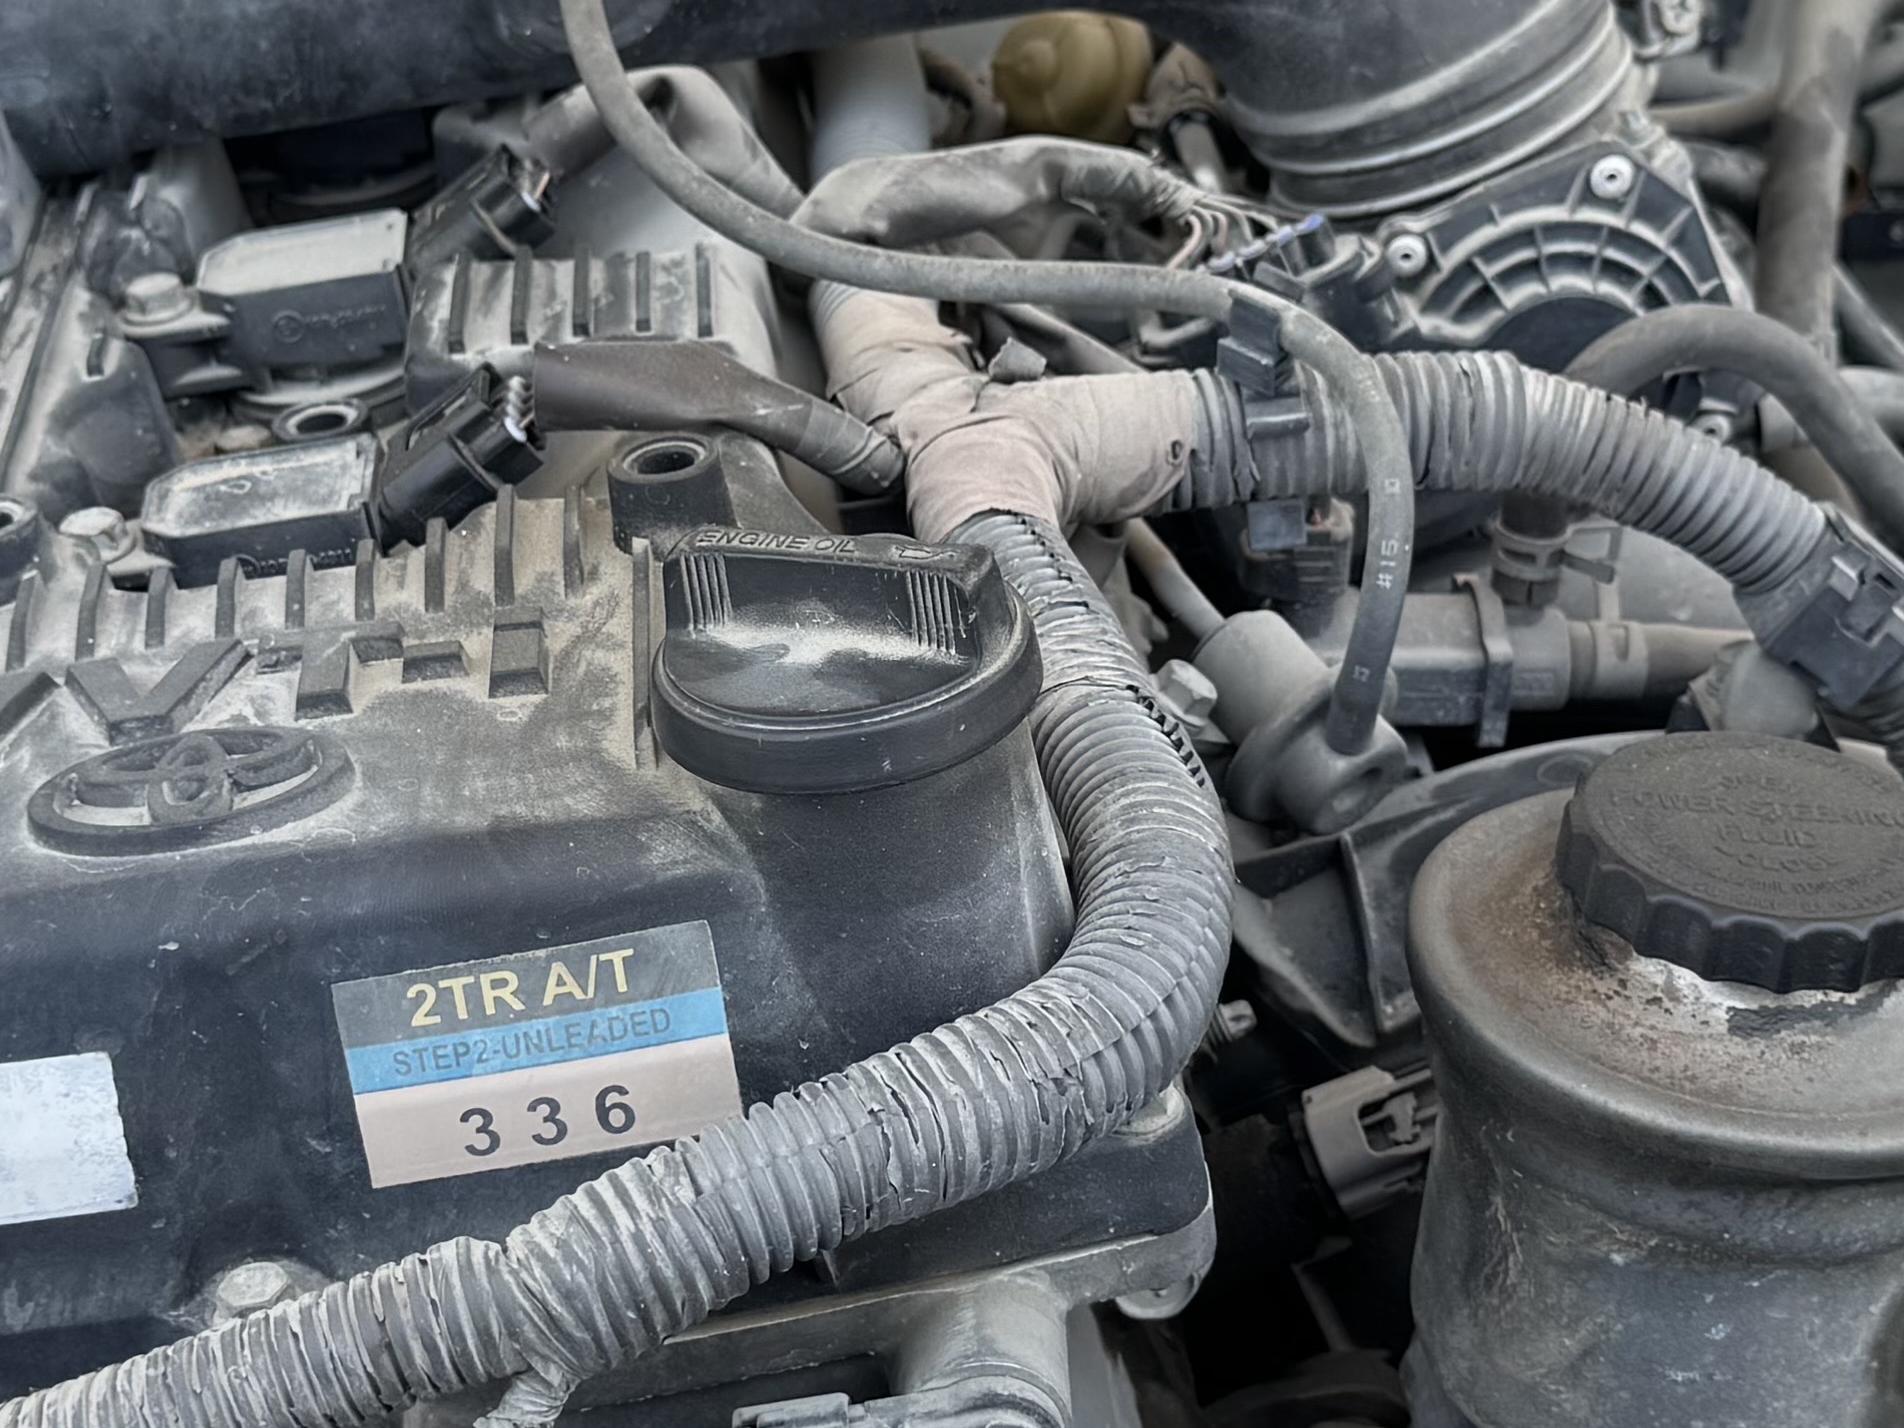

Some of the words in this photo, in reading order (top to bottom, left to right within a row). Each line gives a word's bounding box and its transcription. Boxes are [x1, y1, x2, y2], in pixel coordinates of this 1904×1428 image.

[696, 529, 810, 551] ENGINE
[813, 536, 857, 554] OIL
[1716, 823, 1818, 849] FLUID
[405, 969, 527, 1028] 2TR
[542, 947, 635, 1007] A/T
[392, 1006, 672, 1077] STEP2-UNLEADED
